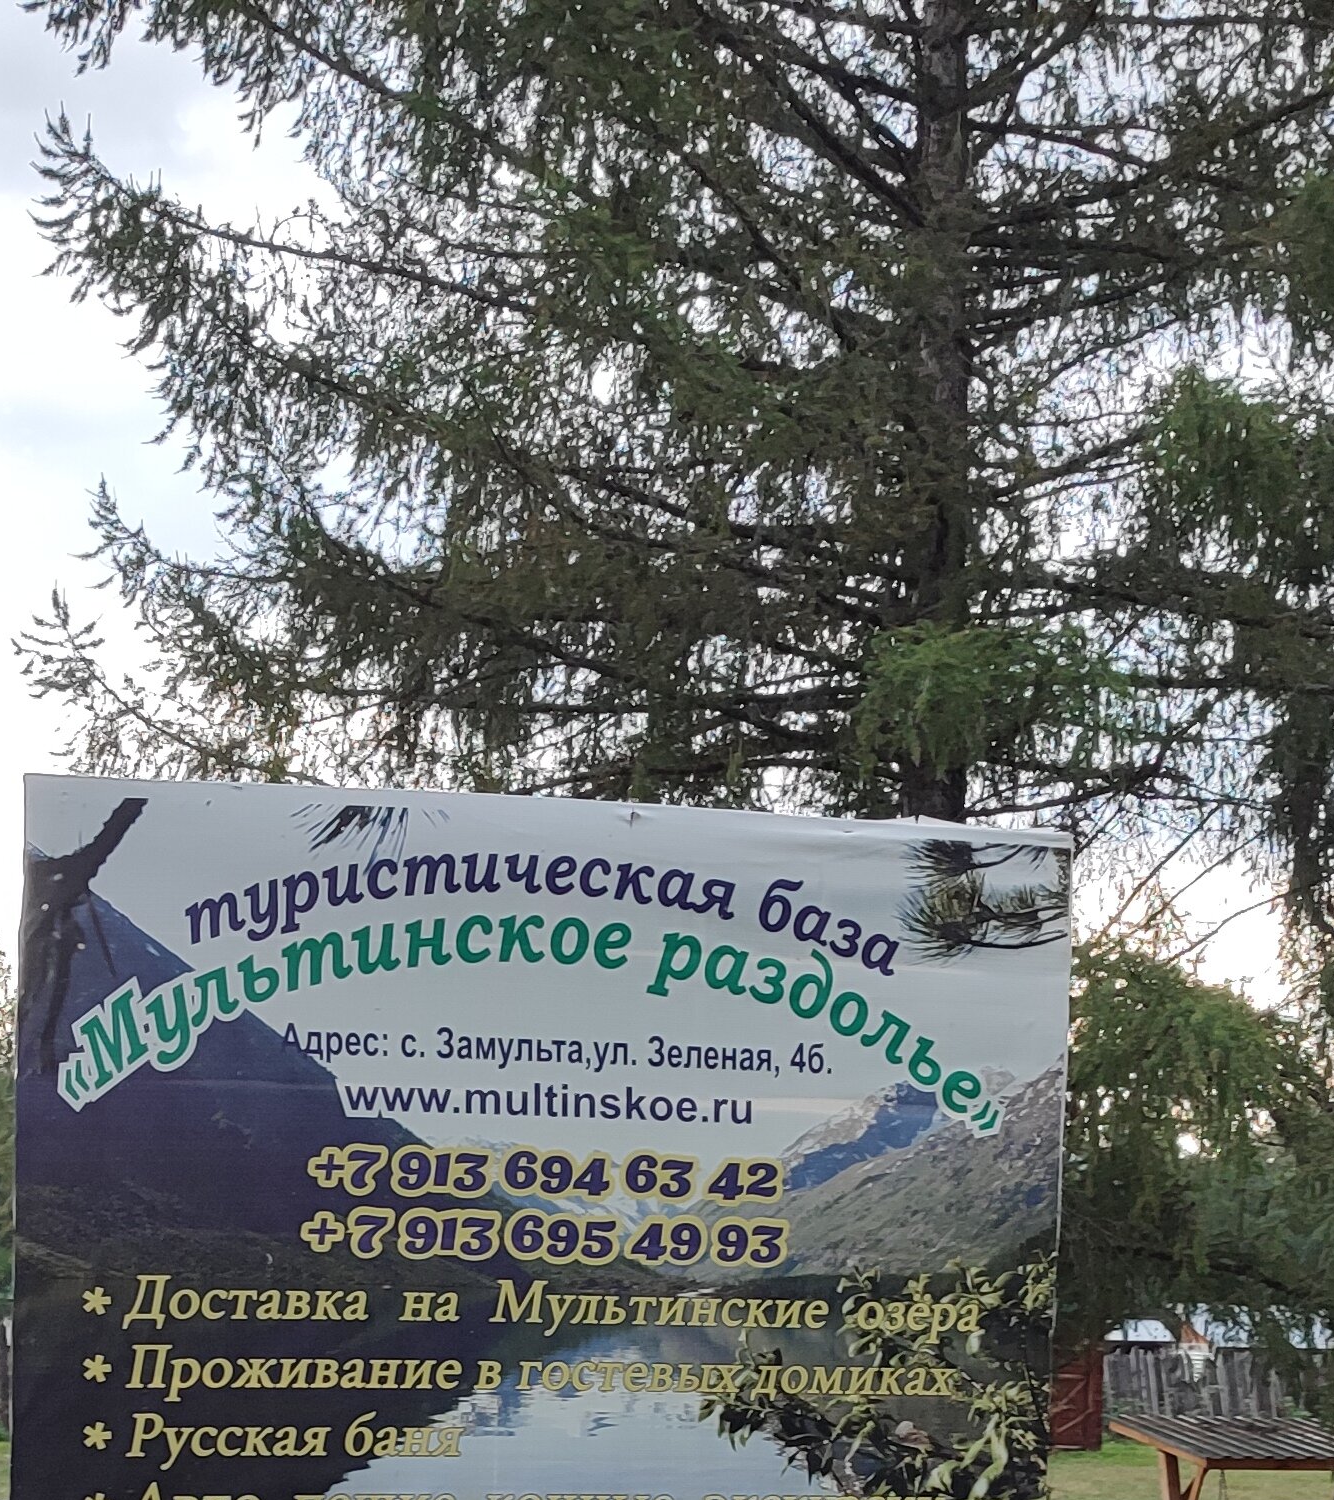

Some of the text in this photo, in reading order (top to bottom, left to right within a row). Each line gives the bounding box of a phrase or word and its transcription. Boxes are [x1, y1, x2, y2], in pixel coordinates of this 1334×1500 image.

[185, 852, 901, 976] туристическая база
[63, 913, 1001, 1131] «Мультинское раздолье»
[283, 1023, 389, 1061] Адрес:
[401, 1035, 425, 1059] с.
[647, 1036, 782, 1077] Зеленая,
[344, 1083, 753, 1124] www.multinskoe.ru
[312, 1147, 781, 1202] +7 913 694 63 42
[304, 1208, 787, 1266] +7 913 695 49 93
[122, 1274, 369, 1330] Доставка
[399, 1291, 460, 1323] на
[489, 1279, 829, 1335] Мультинские
[125, 1344, 961, 1401] Проживание в гостевых домиках
[125, 1411, 463, 1470] Русская баня
